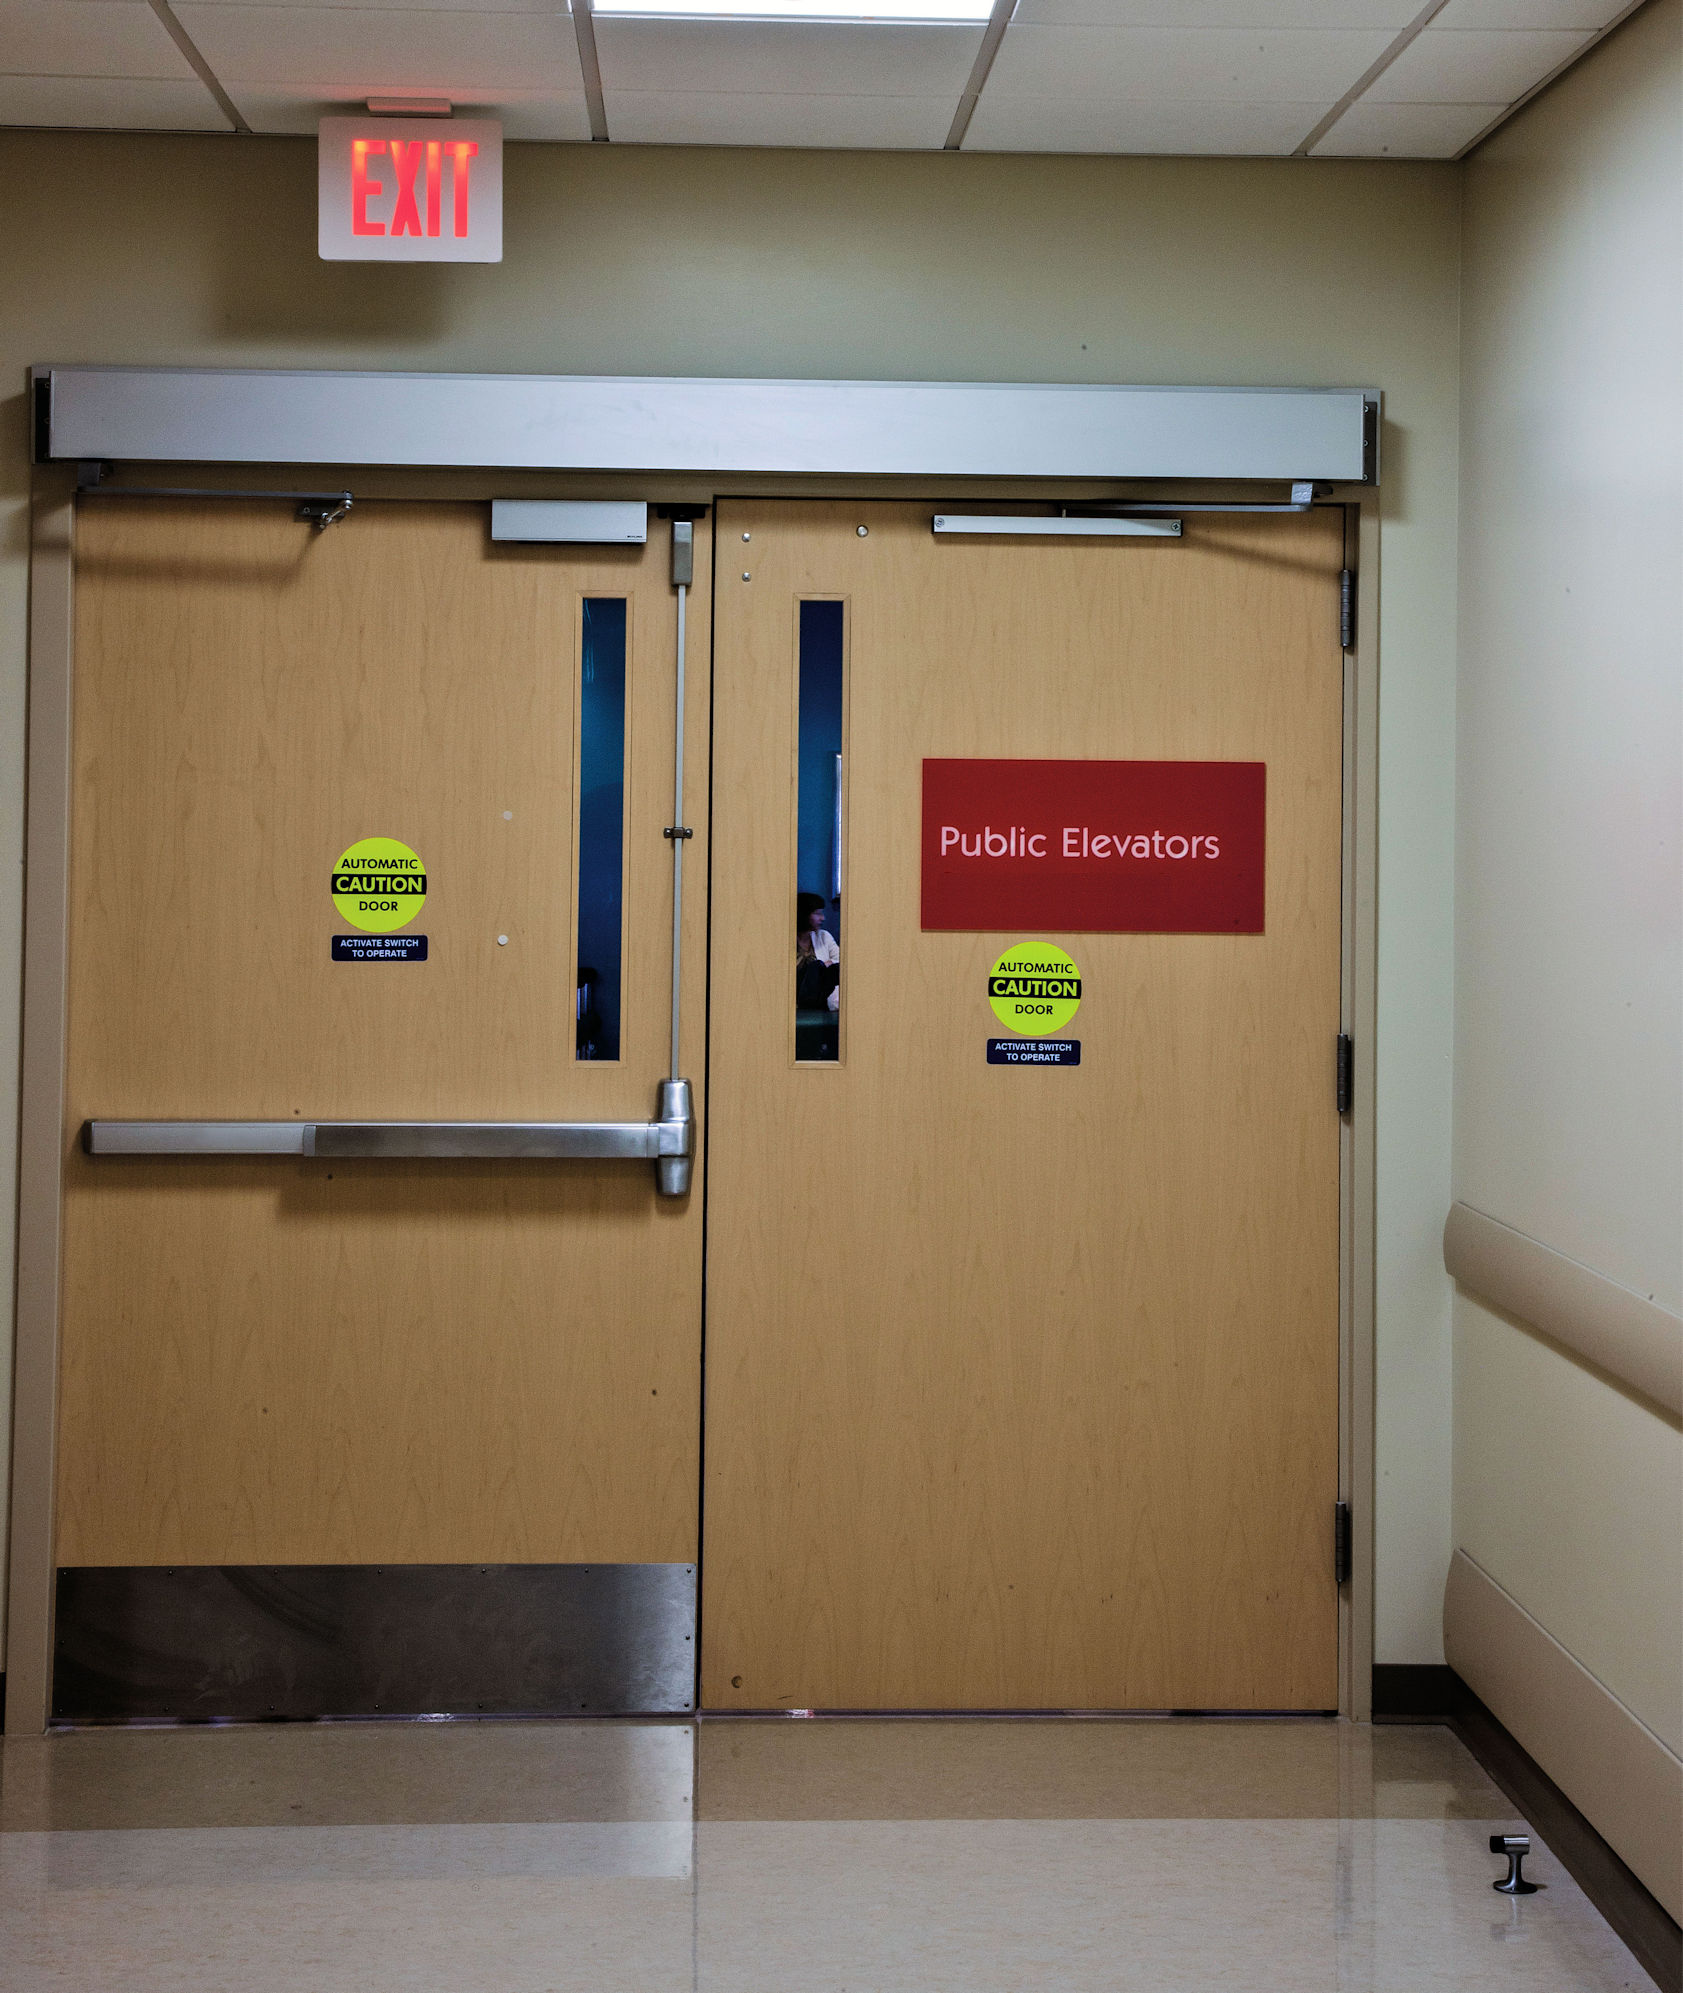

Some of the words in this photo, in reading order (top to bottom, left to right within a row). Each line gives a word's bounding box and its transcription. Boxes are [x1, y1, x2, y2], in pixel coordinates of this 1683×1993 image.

[352, 140, 478, 237] EXIT
[940, 826, 1047, 858] Public
[1062, 827, 1220, 859] Elevators
[341, 858, 418, 869] AUTOMATIC
[336, 876, 422, 892] CAUTION
[359, 901, 398, 911] DOOR
[340, 939, 382, 947] ACTIVATE
[384, 939, 419, 947] SWITCH
[352, 949, 364, 957] TO
[366, 949, 407, 957] OPERATE
[998, 962, 1073, 974] AUTOMATIC
[993, 979, 1077, 996] CAUTION
[1015, 1004, 1053, 1015] DOOR
[995, 1042, 1036, 1051] ACTIVATE
[1038, 1043, 1072, 1052] SWITCH
[1006, 1052, 1019, 1061] TO
[1020, 1053, 1060, 1062] OPERATE
